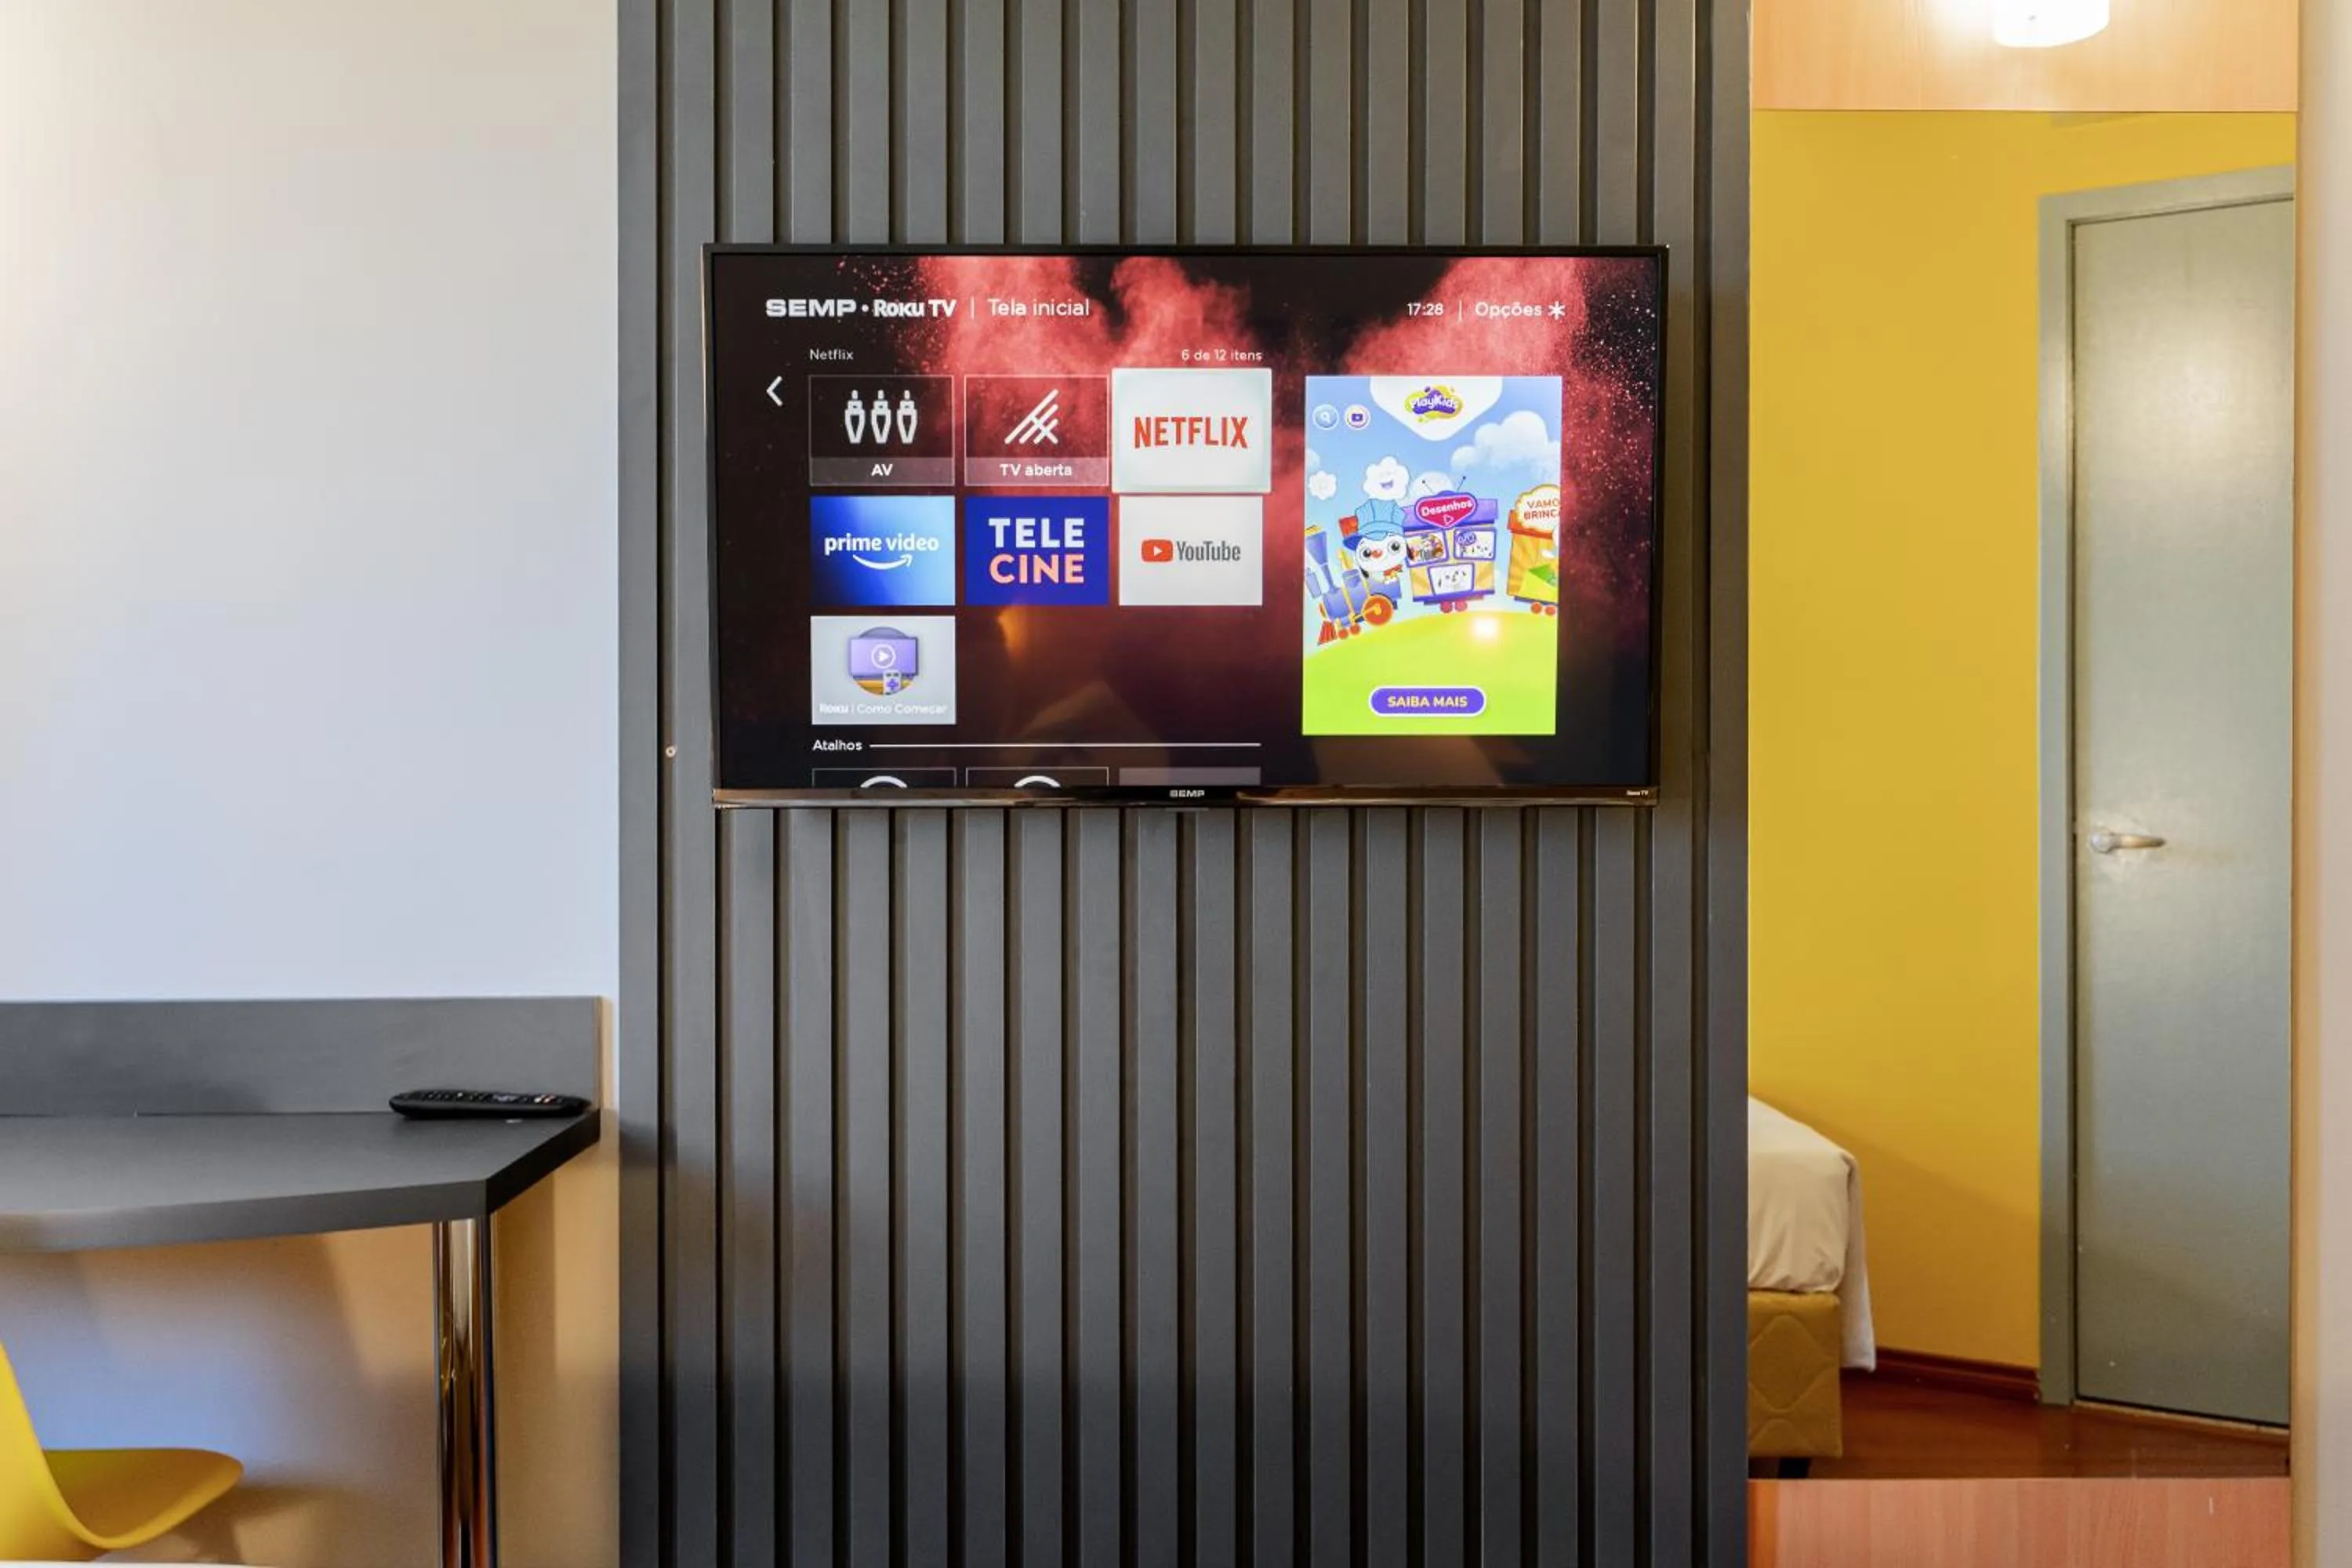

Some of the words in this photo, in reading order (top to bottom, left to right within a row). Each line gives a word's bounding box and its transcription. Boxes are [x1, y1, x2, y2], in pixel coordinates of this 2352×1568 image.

[765, 299, 857, 318] SEMP
[873, 299, 924, 318] Roku
[927, 299, 957, 318] TV
[987, 298, 1026, 317] Tela
[1033, 298, 1091, 317] inicial
[1406, 303, 1444, 317] 17:28
[1475, 301, 1543, 320] Opções
[809, 349, 854, 361] Netflix
[1181, 350, 1190, 361] 6
[1194, 350, 1210, 361] de
[1214, 350, 1227, 361] 12
[1230, 350, 1263, 361] itens
[1134, 416, 1249, 449] NETFLIX
[871, 464, 894, 477] AV
[1000, 463, 1022, 477] TV
[1025, 464, 1073, 477] aberta
[1421, 499, 1473, 517] Desenhos
[988, 517, 1085, 548] TELE
[824, 532, 883, 556] prime
[885, 533, 940, 551] video
[1176, 540, 1242, 561] YouTube
[989, 554, 1085, 584] CINE
[1387, 695, 1430, 708] SAIBA
[1432, 695, 1468, 708] MAIS
[812, 739, 863, 751] Atalhos
